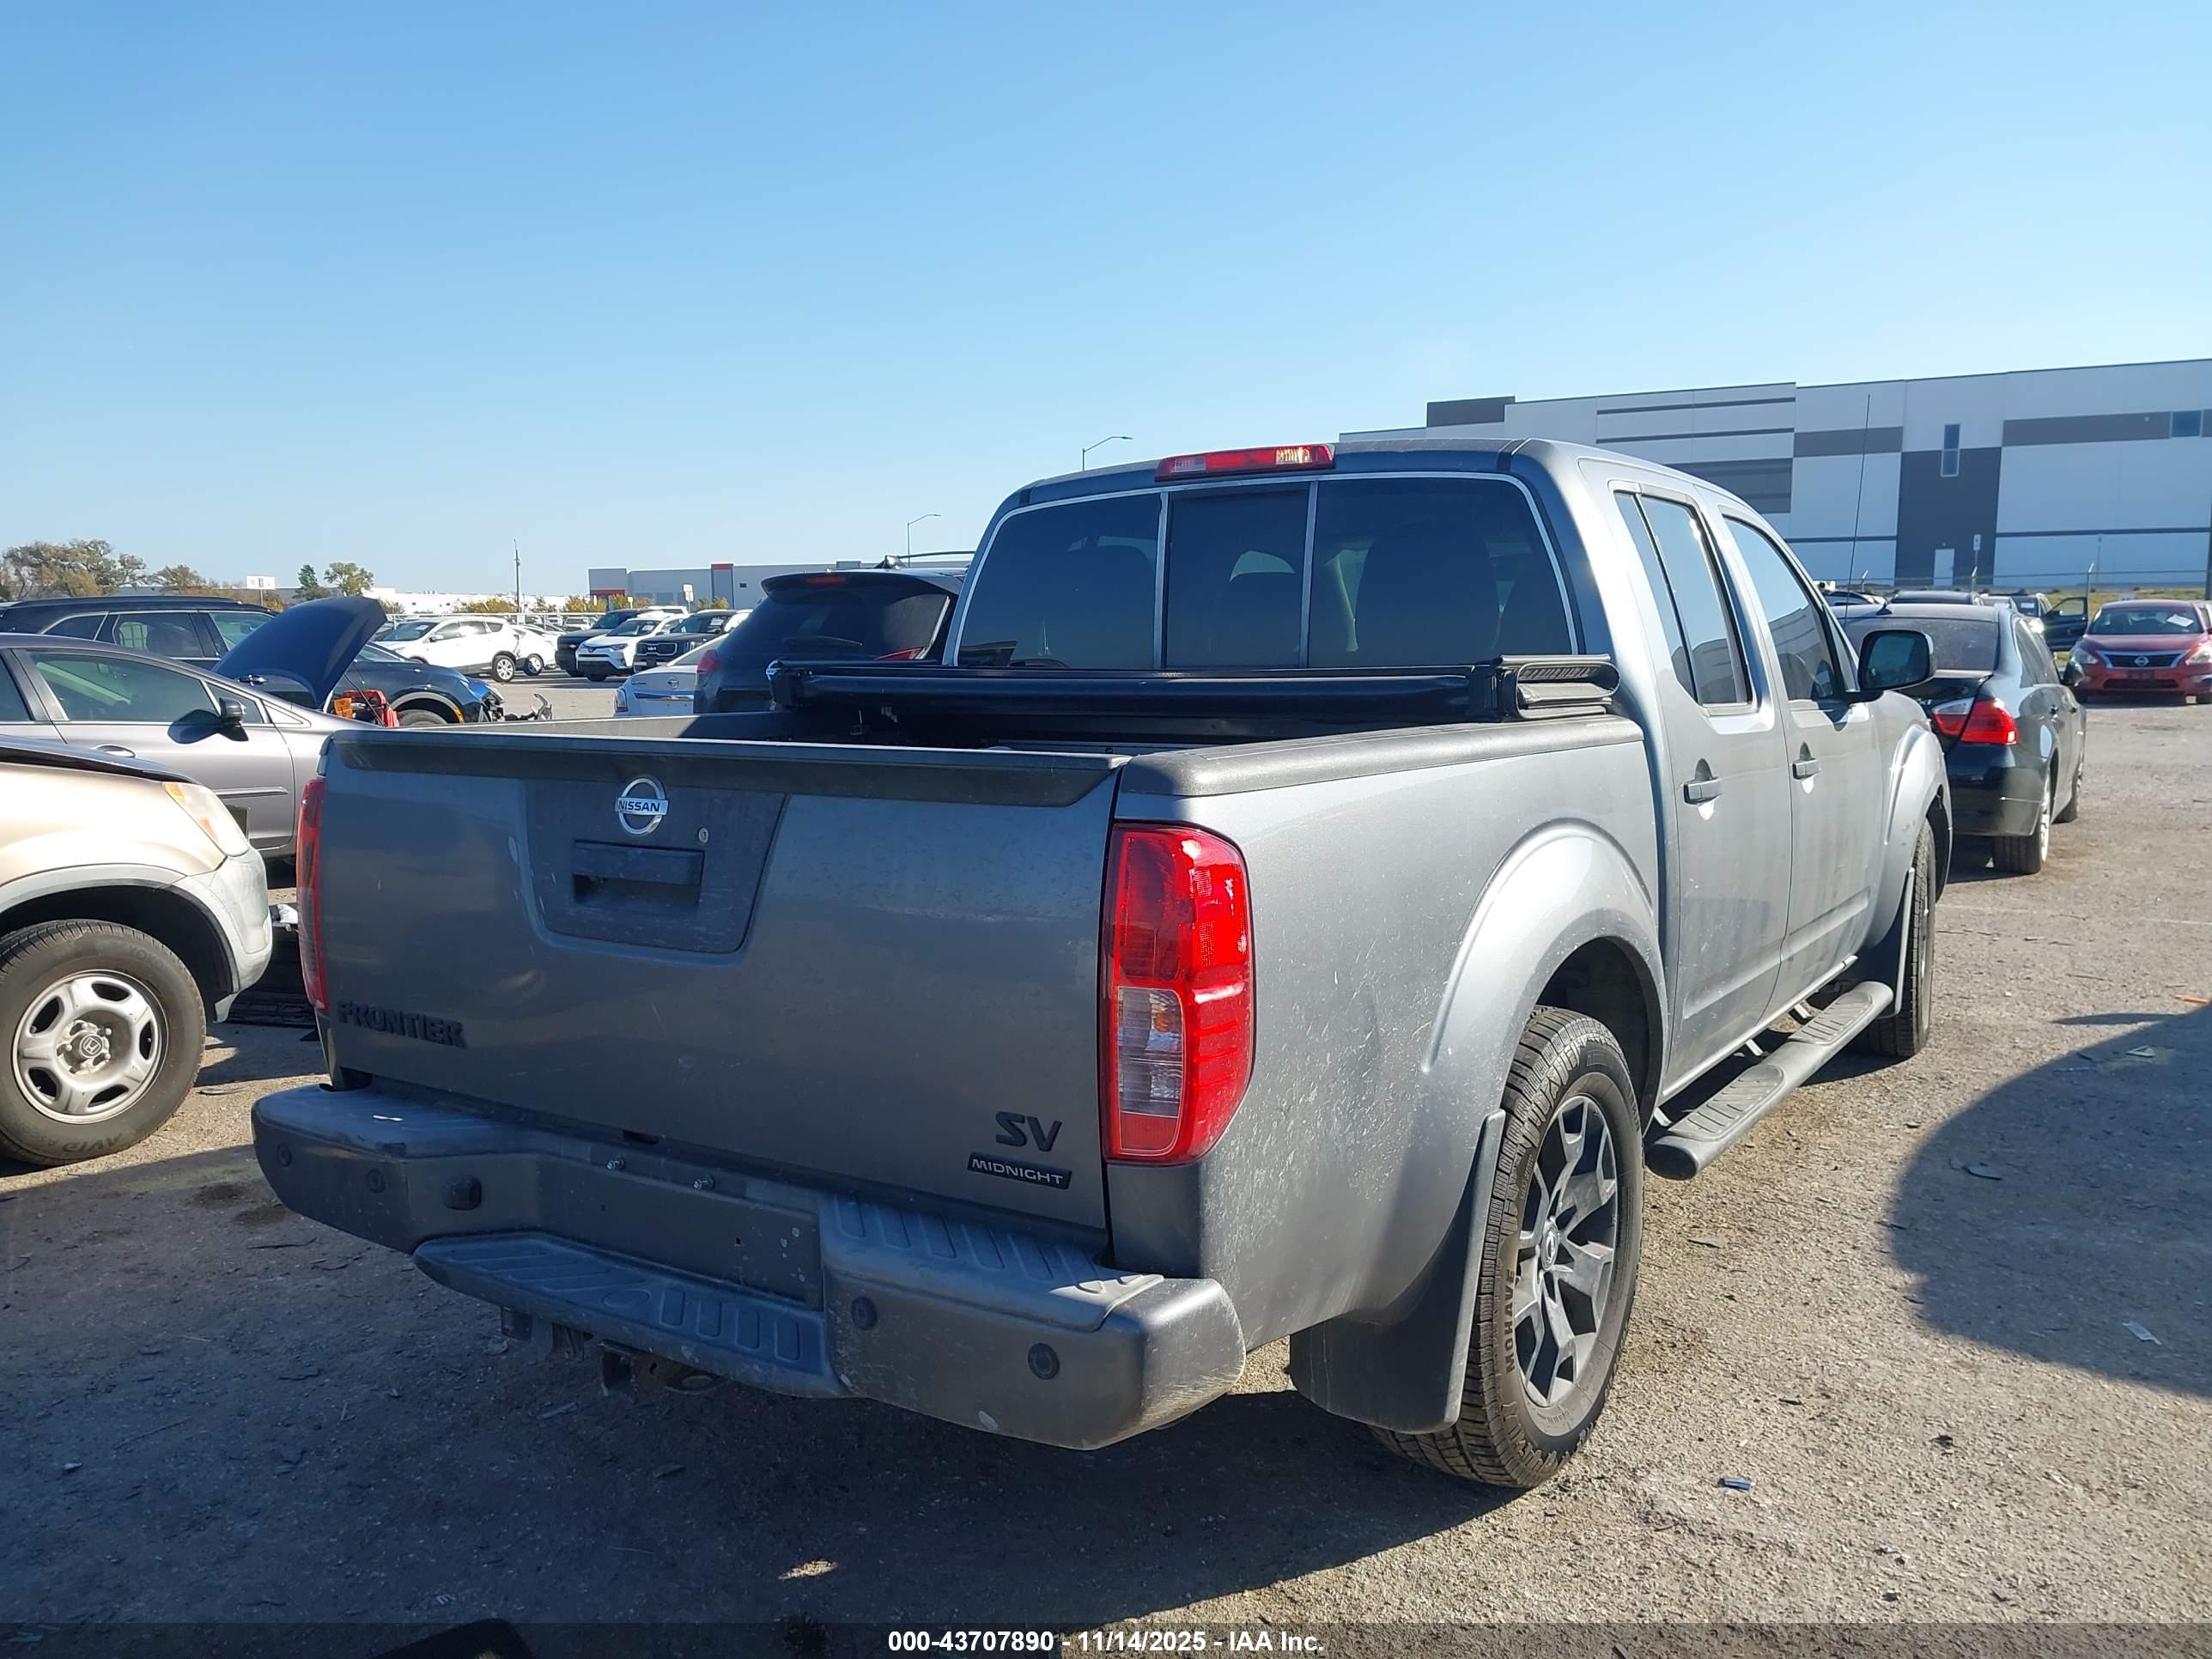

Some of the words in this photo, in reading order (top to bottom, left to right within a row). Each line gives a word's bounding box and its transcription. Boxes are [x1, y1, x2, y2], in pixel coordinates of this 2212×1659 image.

[618, 800, 659, 811] NISSAN
[337, 1000, 467, 1049] FRONTIER
[995, 1111, 1063, 1152] SV
[971, 1158, 1064, 1185] MIDNIGHT
